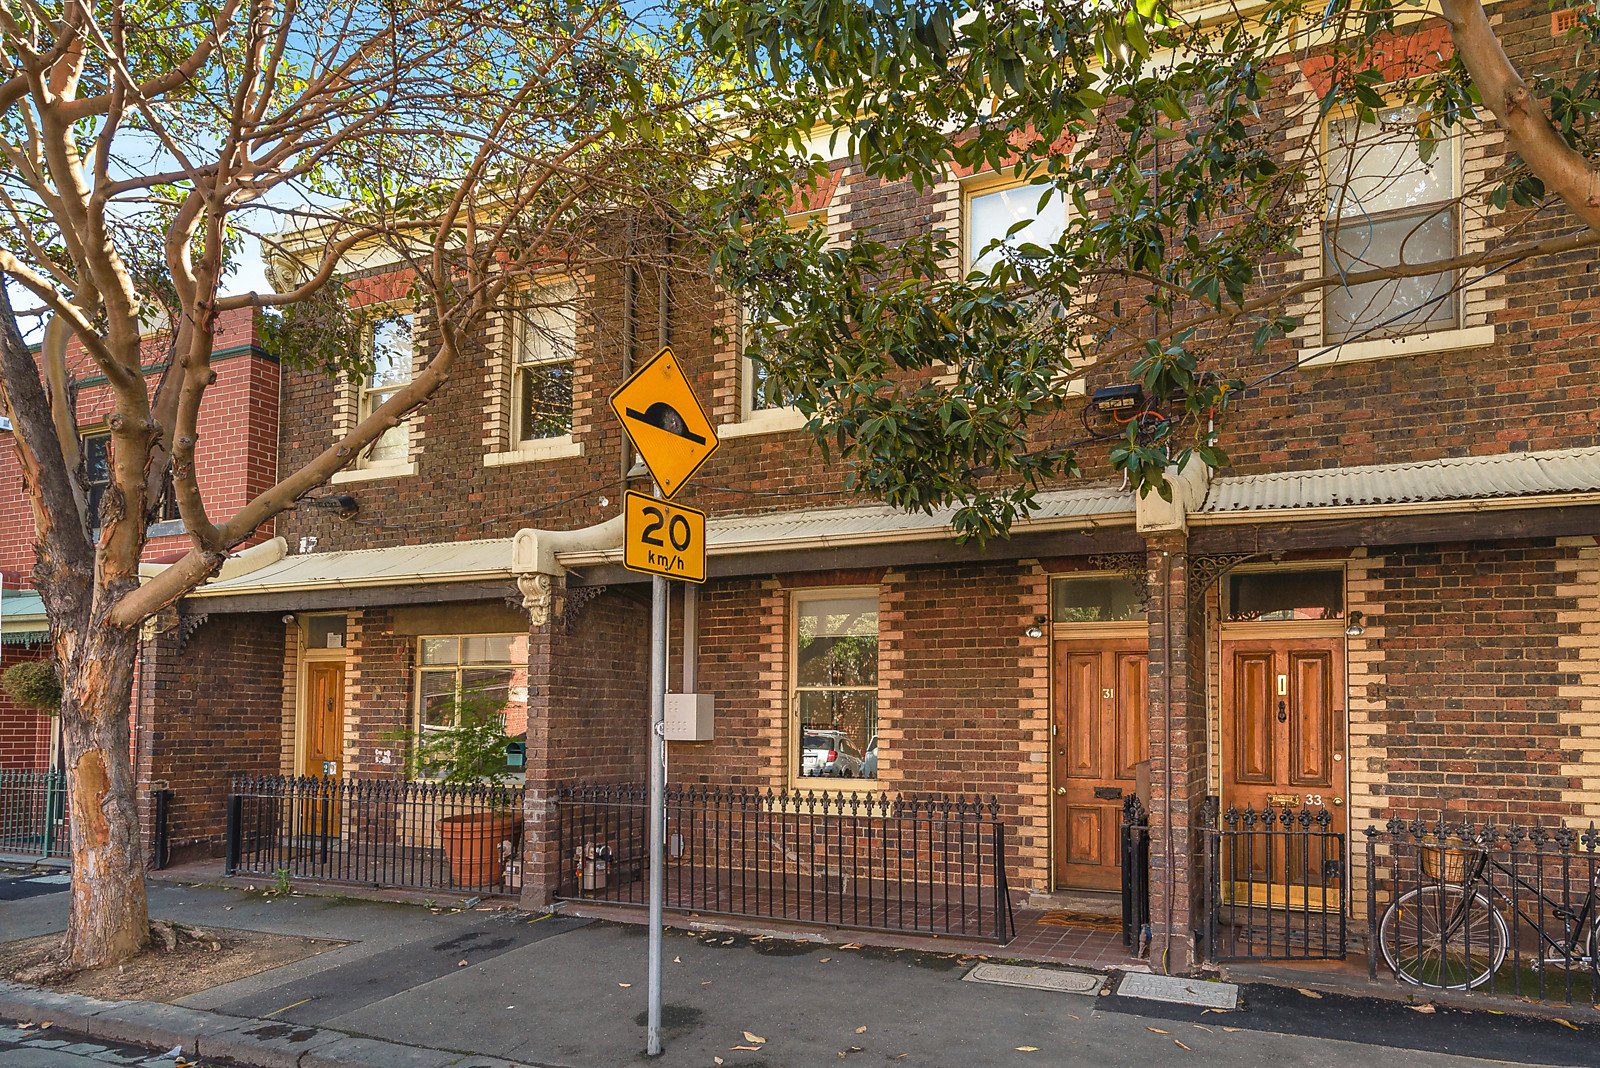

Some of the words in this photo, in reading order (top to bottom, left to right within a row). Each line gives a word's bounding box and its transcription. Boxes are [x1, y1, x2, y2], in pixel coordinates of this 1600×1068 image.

[641, 506, 691, 552] 20
[648, 549, 684, 571] km/h
[1102, 688, 1114, 699] 31
[1305, 793, 1322, 806] 33
